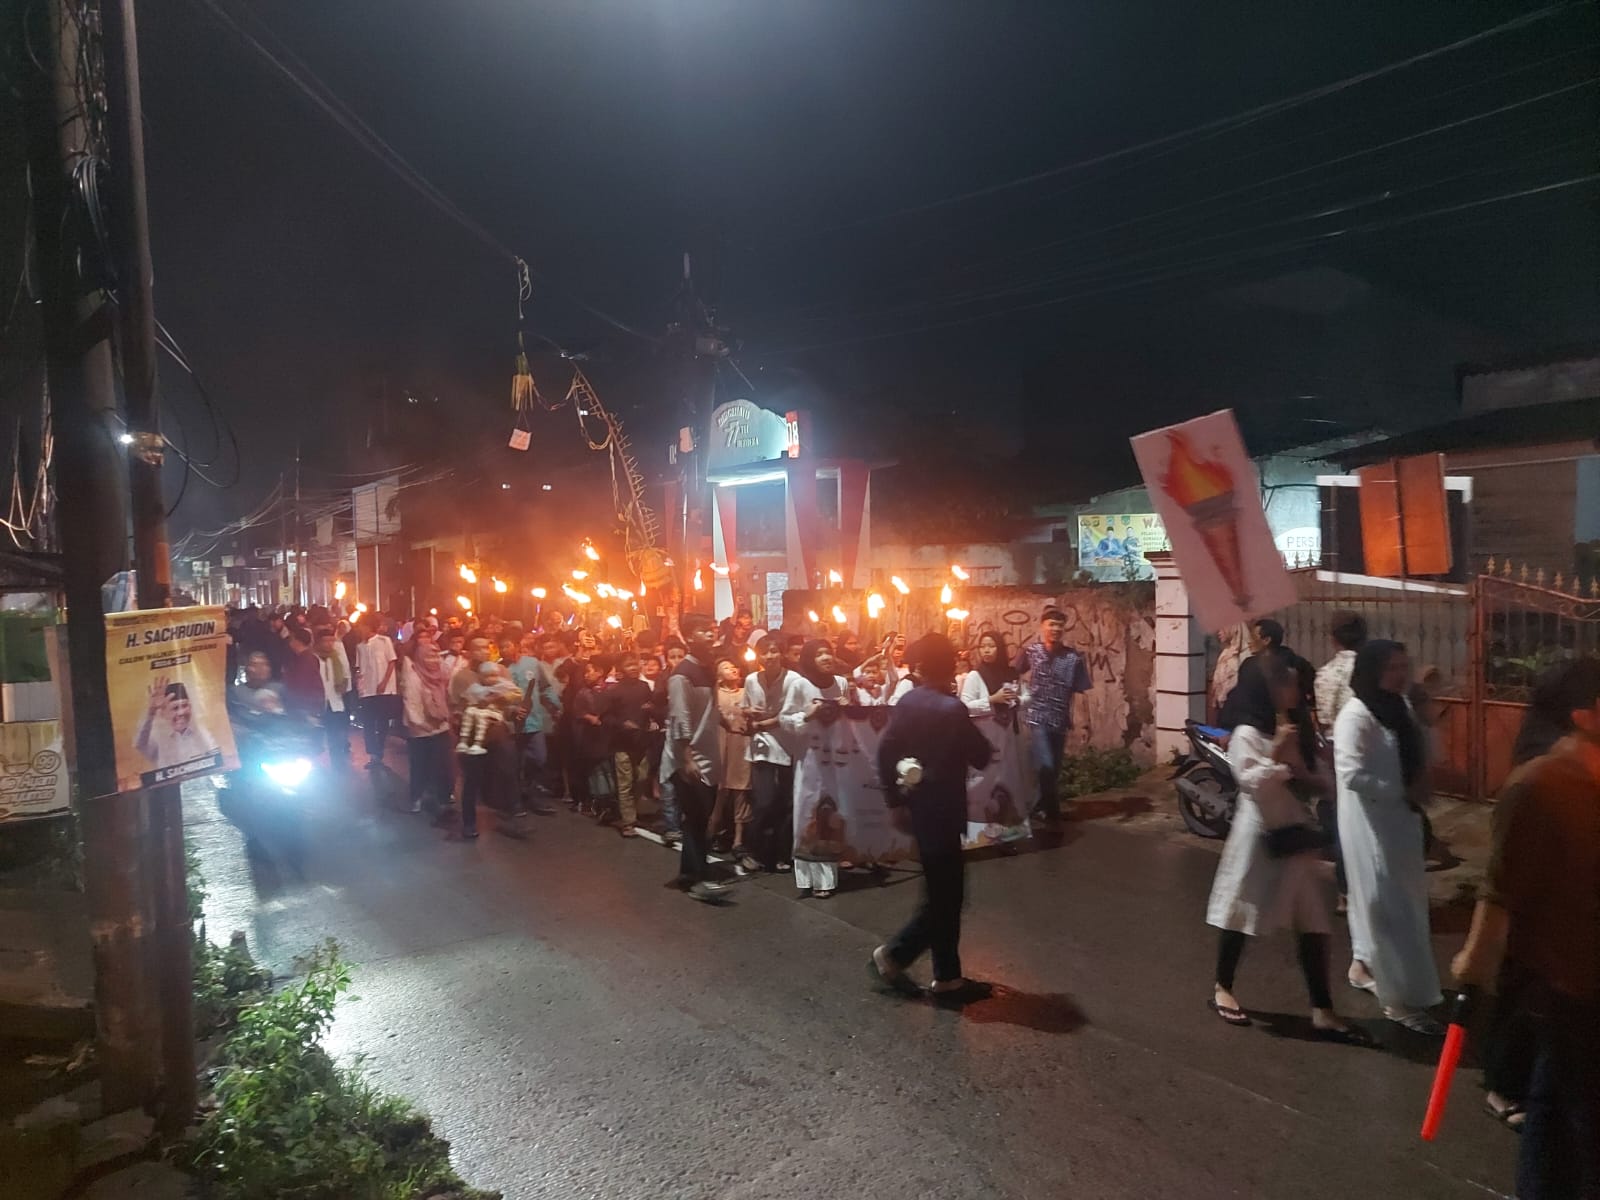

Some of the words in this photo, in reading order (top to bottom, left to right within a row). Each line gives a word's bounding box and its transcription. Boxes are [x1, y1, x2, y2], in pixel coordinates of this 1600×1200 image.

[126, 633, 141, 649] H.
[143, 621, 216, 646] SACHRUDIN
[0, 790, 56, 807] anyumas
